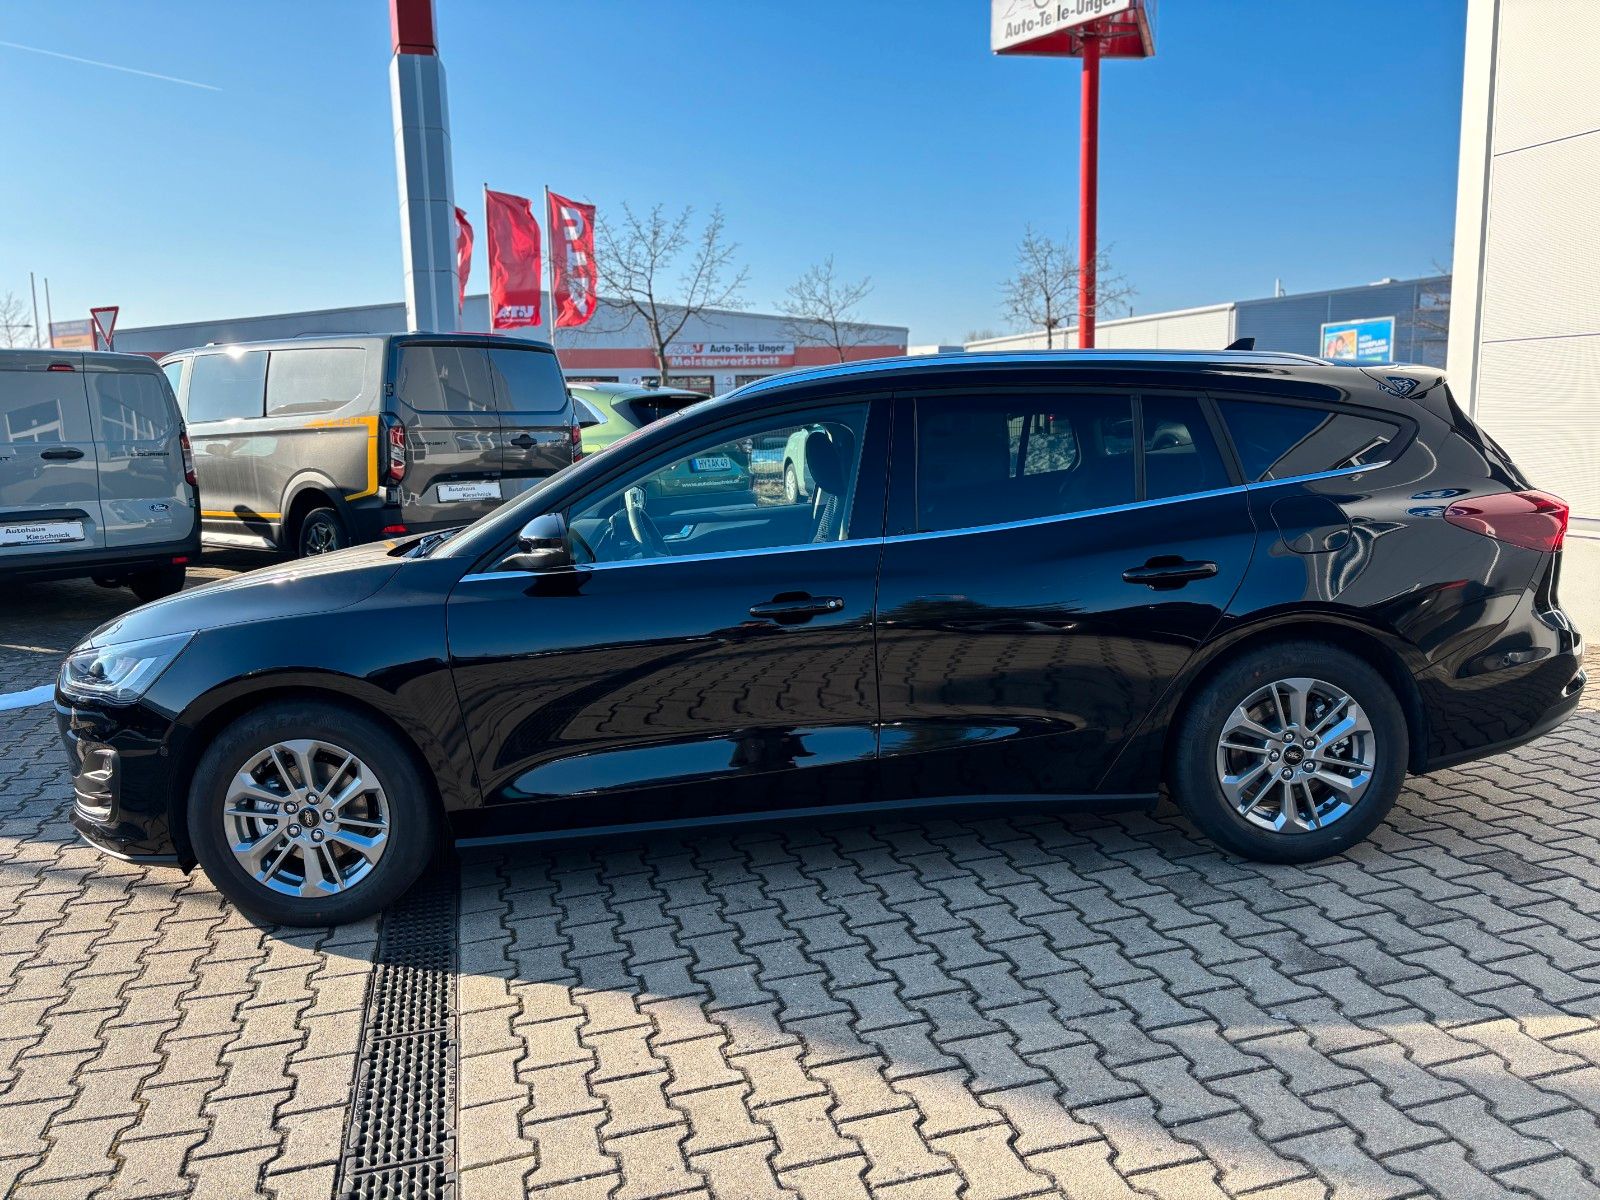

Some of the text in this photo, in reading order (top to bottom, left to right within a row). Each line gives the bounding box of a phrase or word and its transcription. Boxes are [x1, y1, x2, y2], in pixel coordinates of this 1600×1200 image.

[1005, 0, 1116, 39] Auto-Tele-Unge
[671, 356, 780, 366] Meisterwerkstatt
[725, 377, 733, 386] 3
[5, 526, 46, 534] Autohaus
[26, 532, 71, 540] Kieschnick
